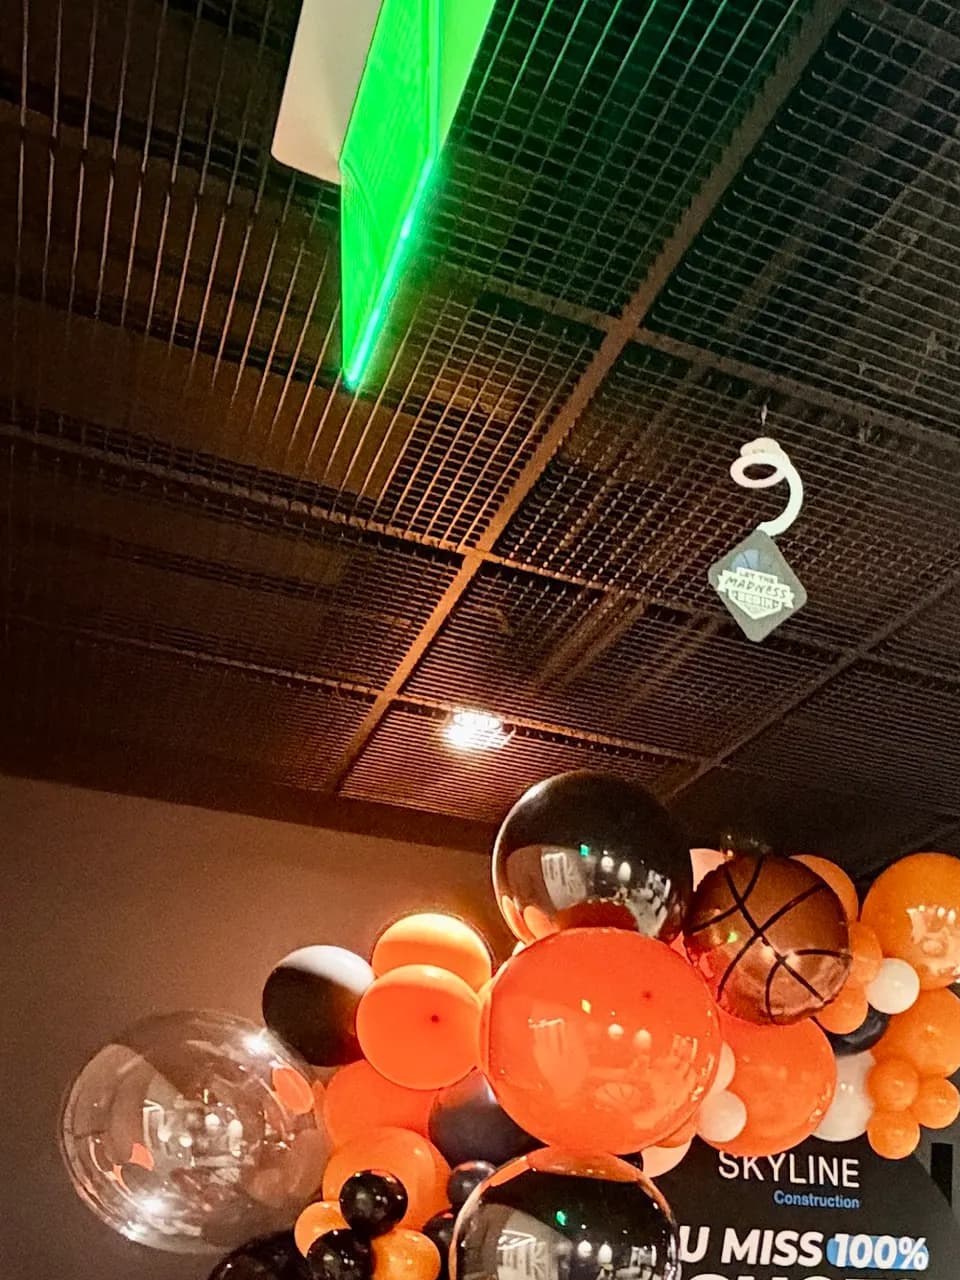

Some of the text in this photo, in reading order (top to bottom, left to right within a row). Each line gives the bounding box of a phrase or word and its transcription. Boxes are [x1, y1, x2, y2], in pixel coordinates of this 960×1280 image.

[724, 575, 789, 599] MADNESS
[718, 1151, 860, 1188] SKYLINE
[774, 1190, 860, 1209] Construction
[721, 1228, 824, 1268] MISS
[834, 1233, 928, 1271] 100%
